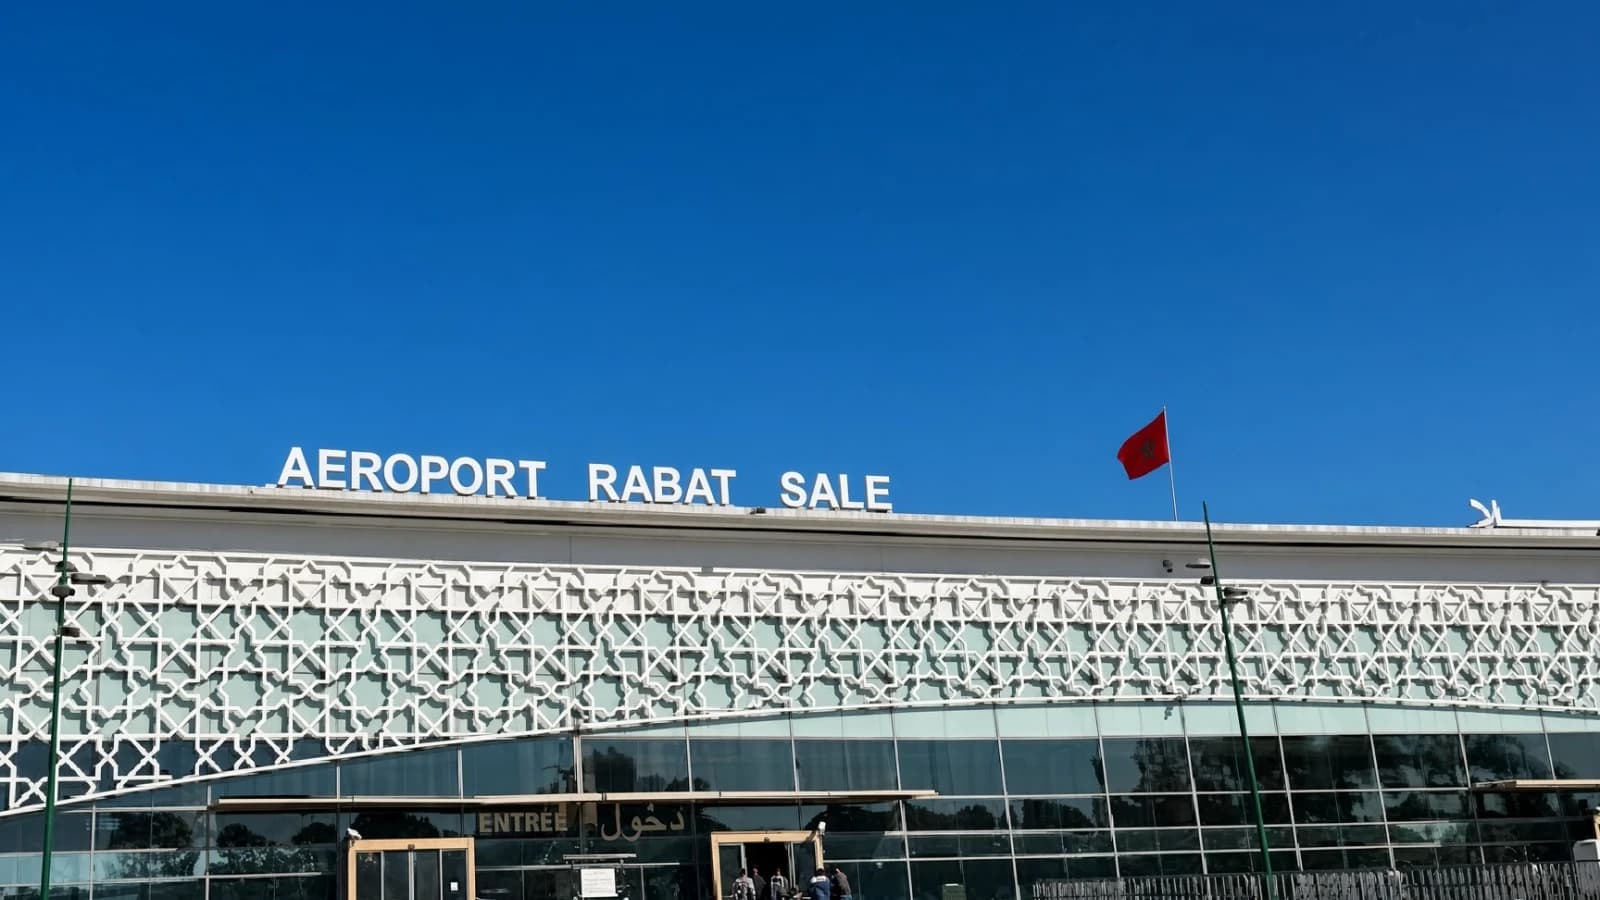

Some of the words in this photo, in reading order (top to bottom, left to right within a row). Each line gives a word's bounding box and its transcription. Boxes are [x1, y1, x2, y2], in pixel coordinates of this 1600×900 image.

[277, 447, 547, 499] AEROPORT
[588, 463, 737, 505] RABAT
[780, 471, 893, 512] SALE
[479, 807, 568, 832] ENTRÉE
